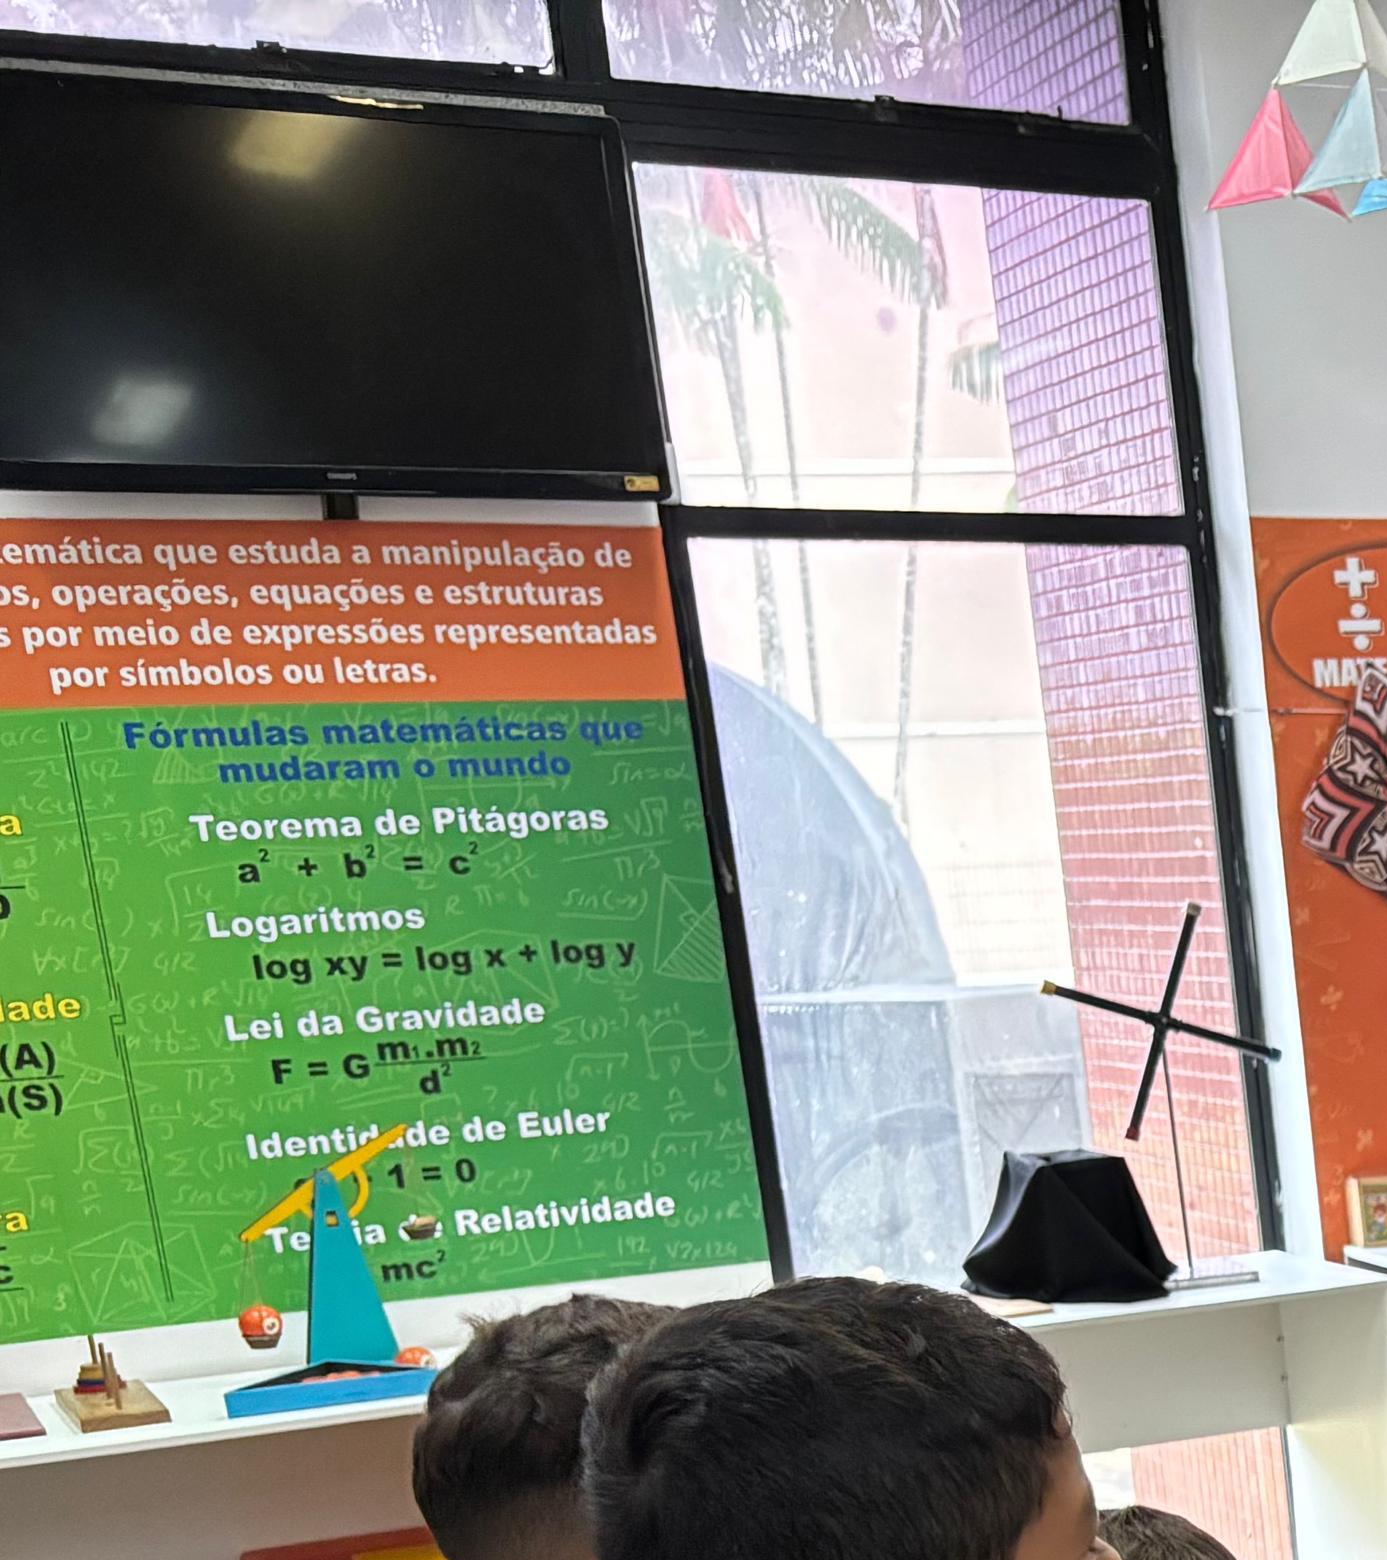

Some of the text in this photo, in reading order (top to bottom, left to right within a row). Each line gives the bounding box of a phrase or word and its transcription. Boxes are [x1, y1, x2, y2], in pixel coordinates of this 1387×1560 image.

[154, 541, 217, 569] que
[229, 541, 341, 566] estuda
[352, 548, 370, 564] a
[382, 540, 584, 574] manipulação
[594, 541, 632, 569] de
[52, 580, 603, 614] operações, equações e estruturas
[23, 618, 656, 654] por meio de expressões representadas
[50, 654, 438, 694] por símbolos ou letras.
[124, 718, 642, 750] Fórmulas matemáticas que
[219, 752, 571, 784] mudaram o mundo
[189, 802, 608, 842] Teorema de Pitágoras
[207, 906, 425, 941] Logaritmos
[224, 999, 545, 1041] Lei da Gravidade
[464, 1110, 610, 1144] de Euler
[457, 1191, 675, 1236] Relatividade
